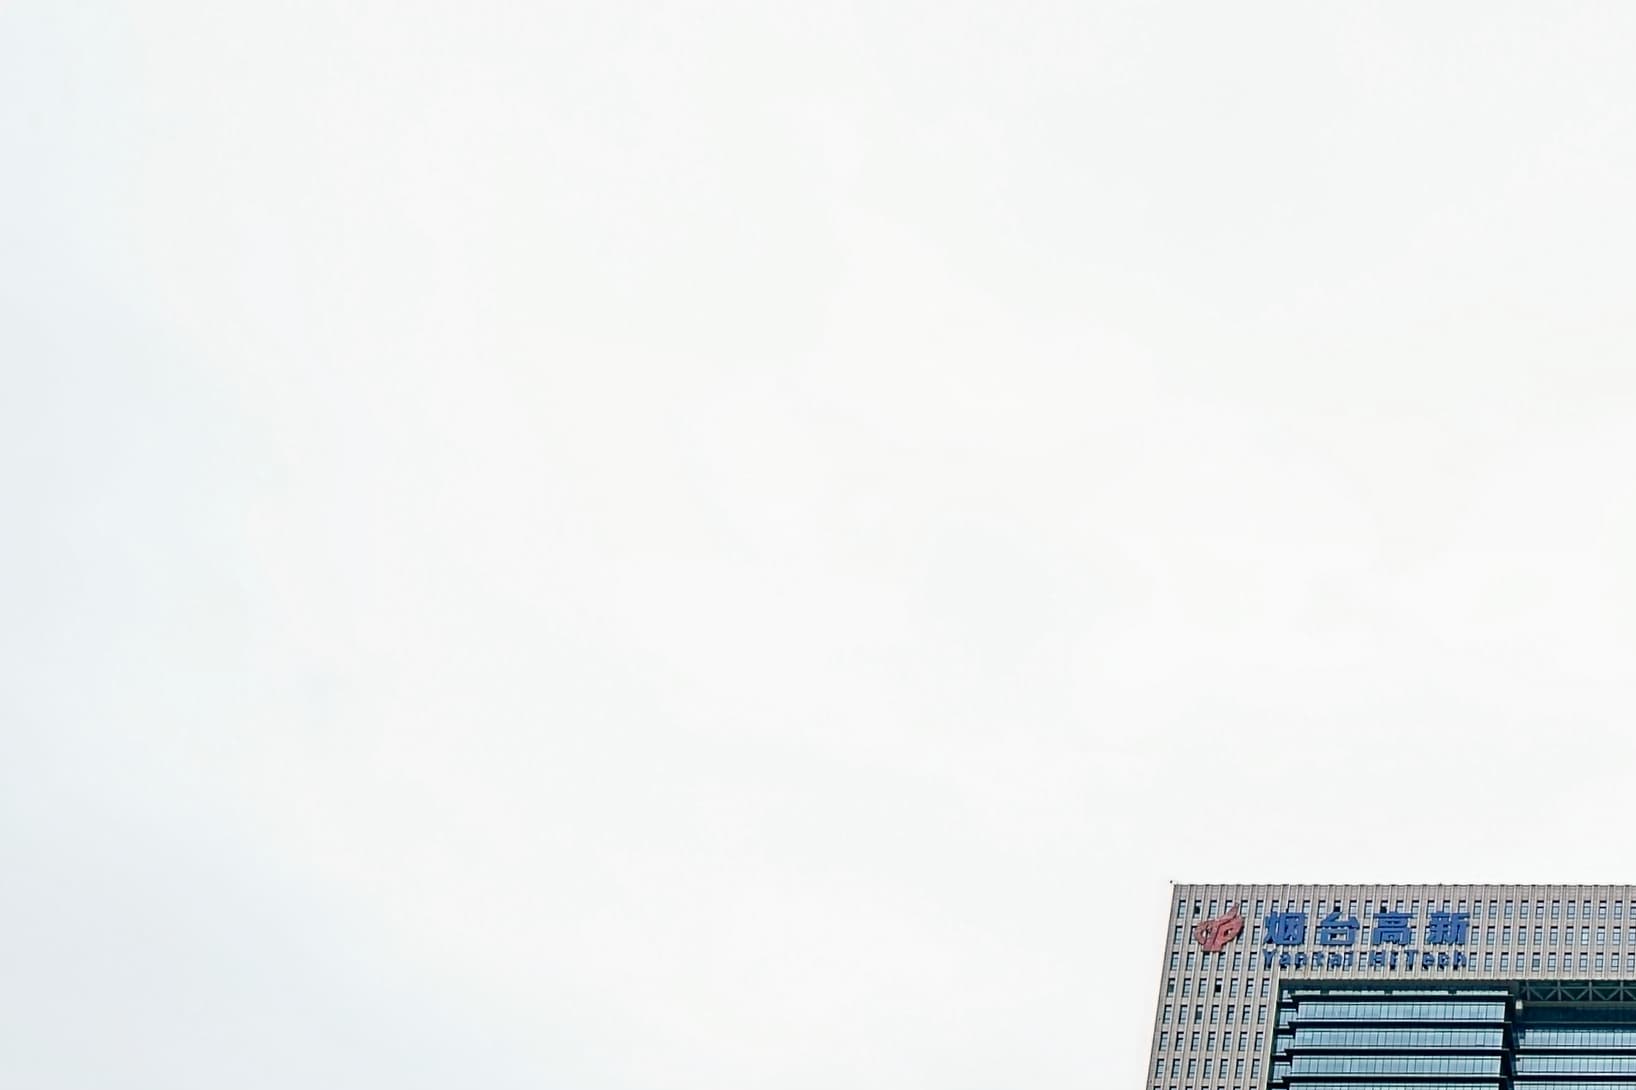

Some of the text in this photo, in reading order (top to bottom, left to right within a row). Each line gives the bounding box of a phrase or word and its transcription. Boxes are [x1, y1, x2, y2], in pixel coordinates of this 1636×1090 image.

[1264, 910, 1471, 946] 烟台高新
[1261, 949, 1355, 970] Yantai
